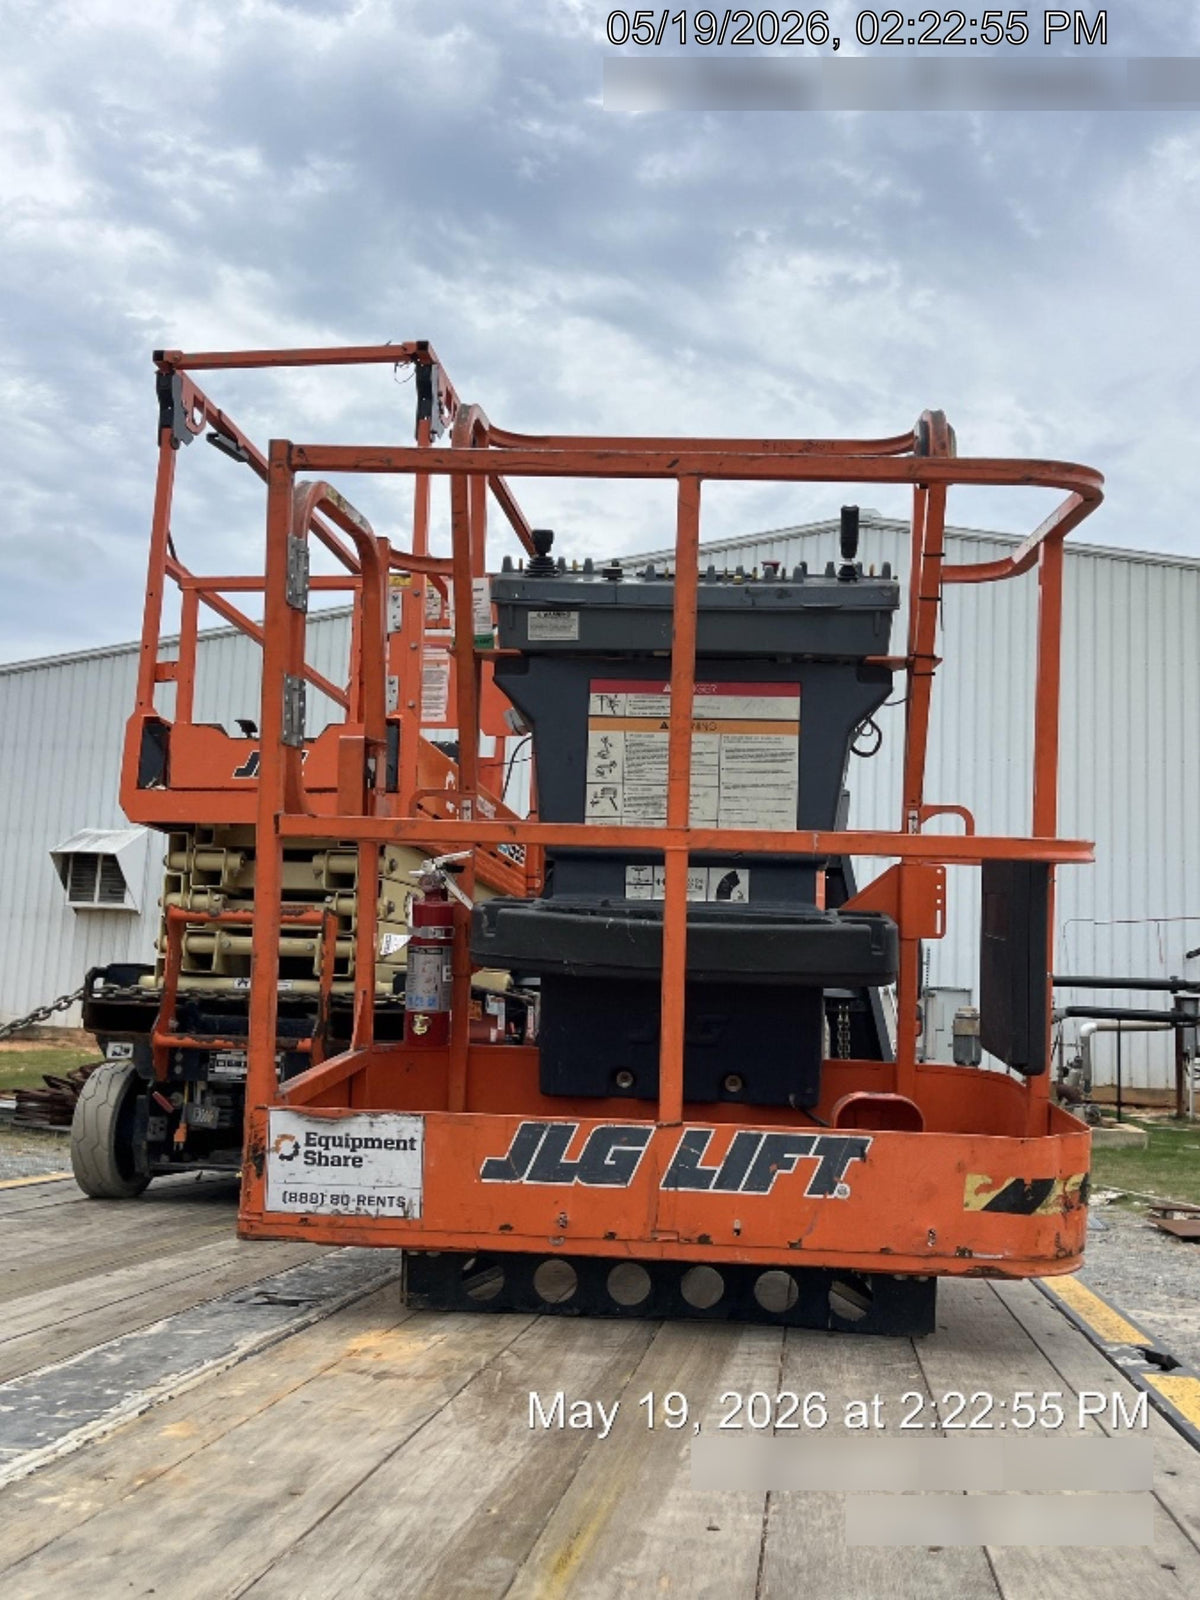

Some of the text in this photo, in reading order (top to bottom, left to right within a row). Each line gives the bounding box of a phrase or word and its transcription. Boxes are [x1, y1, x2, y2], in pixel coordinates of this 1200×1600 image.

[304, 1131, 417, 1152] Equipment
[303, 1150, 364, 1168] Share
[478, 1121, 873, 1199] JLG LIFT
[281, 1190, 407, 1209] (888) 80-RENTS
